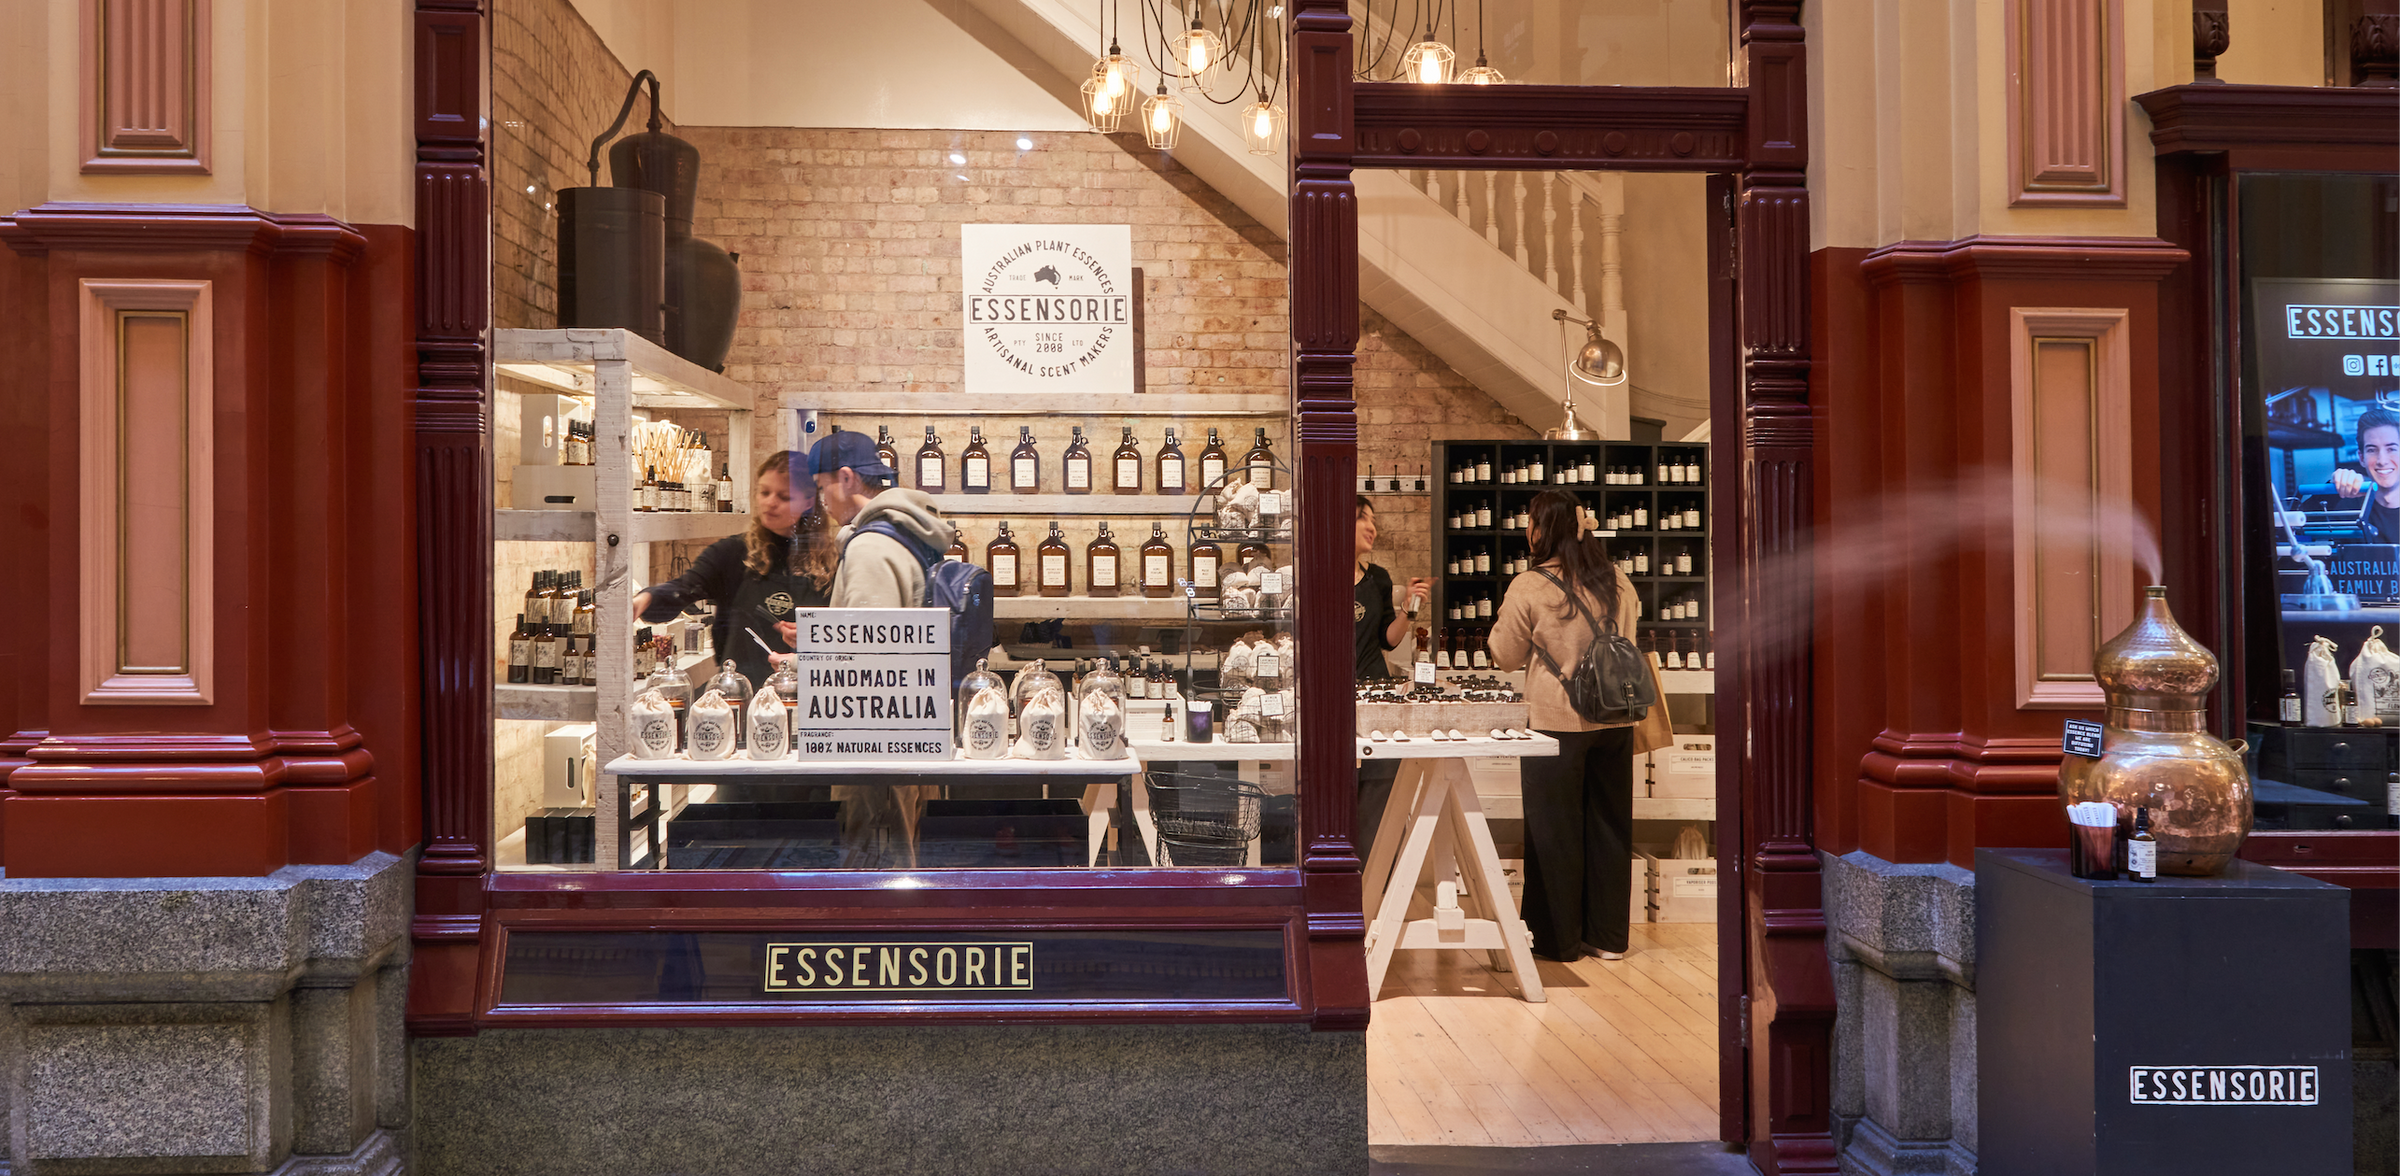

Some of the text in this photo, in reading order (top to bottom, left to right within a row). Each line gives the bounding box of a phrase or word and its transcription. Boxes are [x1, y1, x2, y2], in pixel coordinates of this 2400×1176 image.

[982, 240, 1114, 294] AUSTRALIAN PLANT ESSENCES
[972, 298, 1125, 322] ESSENSORIE
[2290, 308, 2399, 337] ESSENS
[1013, 339, 1026, 347] PTY
[1035, 332, 1063, 342] SINCE
[1036, 343, 1063, 353] 2008
[984, 326, 1113, 377] ARTISANAL SCENT MAKERS
[2338, 579, 2383, 594] FAMILY
[810, 624, 936, 644] ESSENSORIE
[810, 668, 936, 687] HANDMADE IN
[808, 695, 937, 719] AUSTRALIA
[805, 742, 942, 753] 100% NATURAL ESSENCES
[769, 946, 1029, 986] ESSENSORIE
[2134, 1071, 2315, 1100] ESSENSORIE
